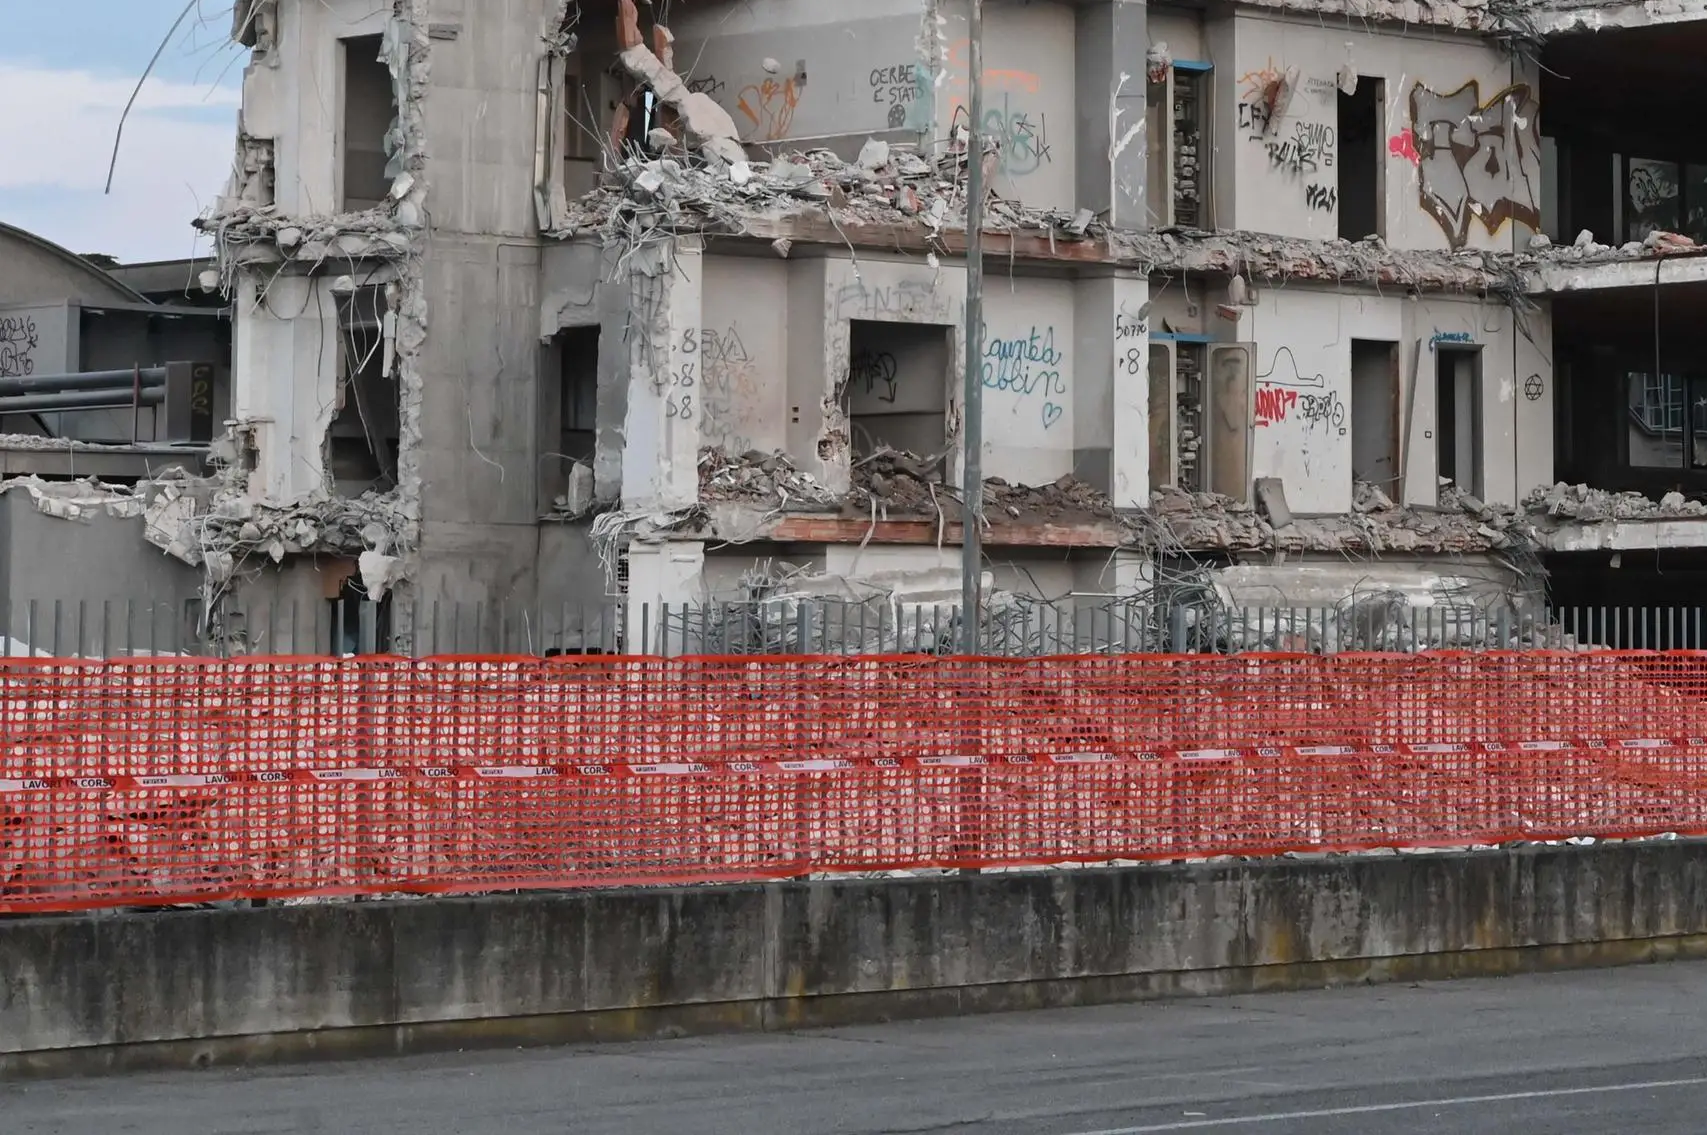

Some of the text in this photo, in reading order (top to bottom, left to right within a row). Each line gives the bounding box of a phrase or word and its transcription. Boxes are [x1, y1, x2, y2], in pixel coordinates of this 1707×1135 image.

[22, 779, 62, 789] LAVORI
[80, 778, 117, 788] CORSO
[204, 773, 243, 784] LAVORI
[260, 771, 294, 781] CORSO
